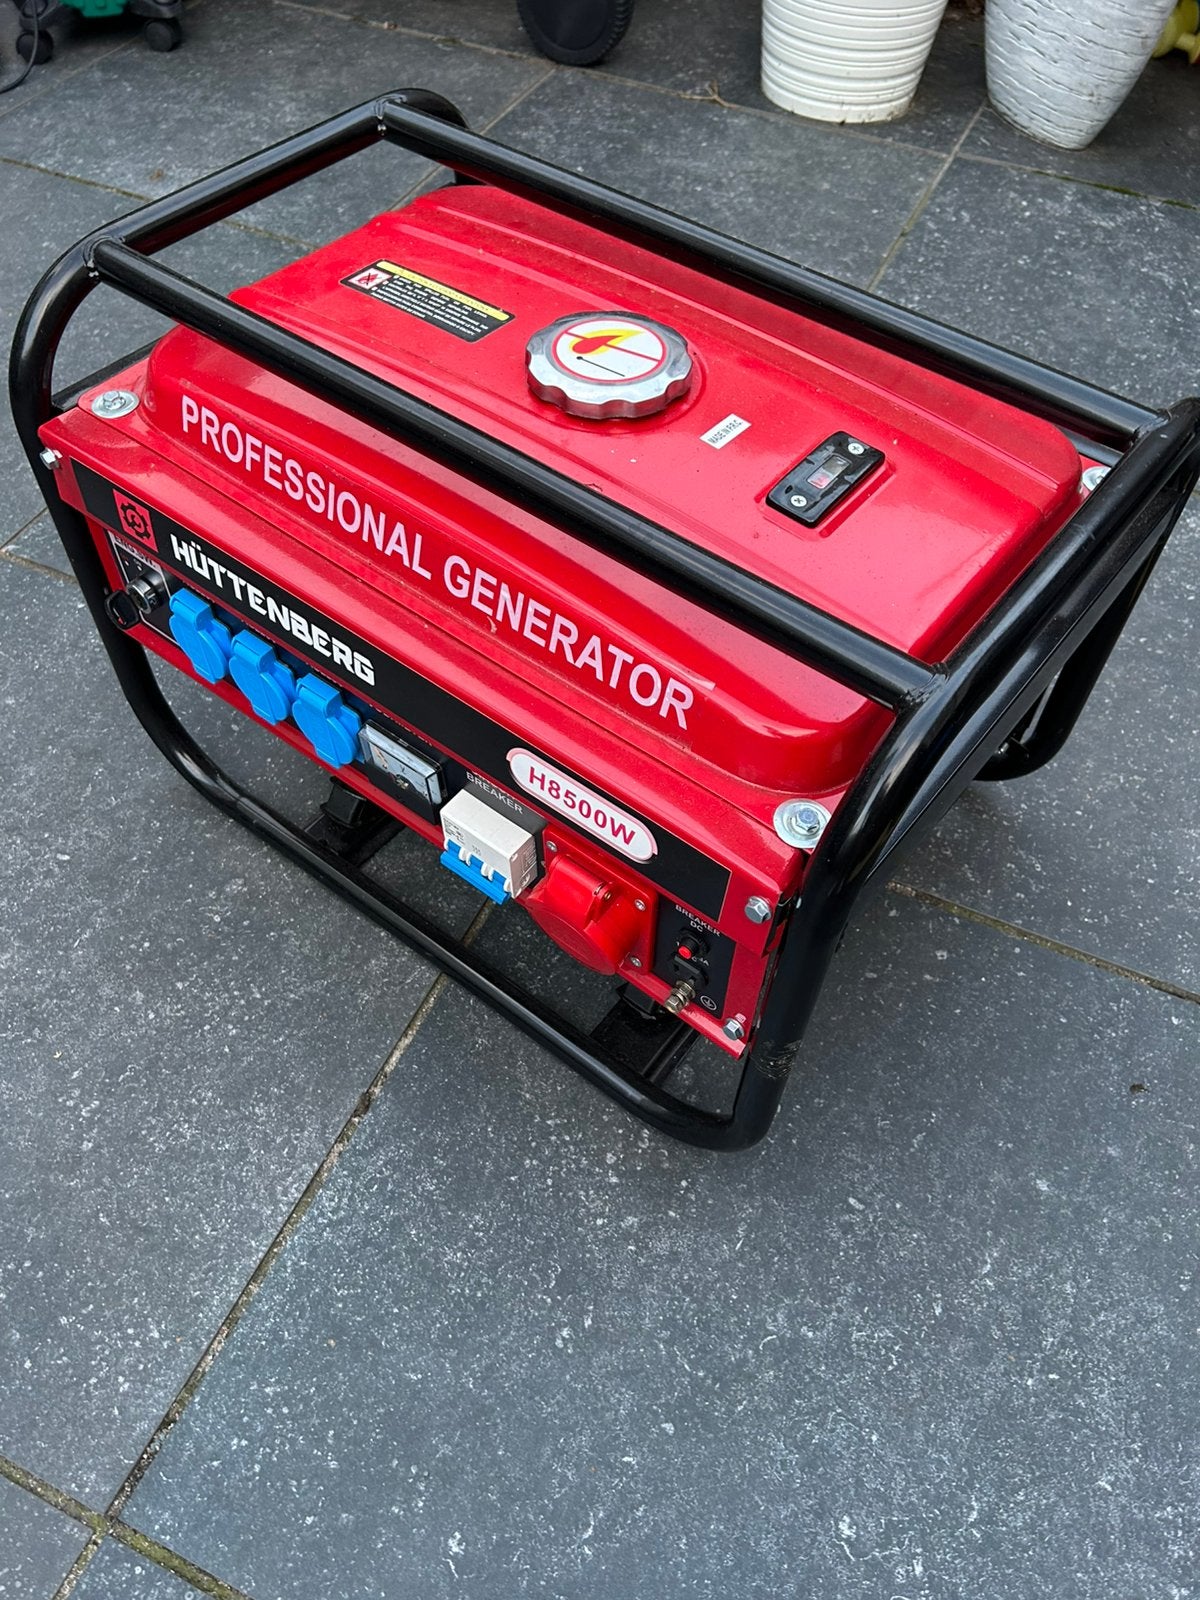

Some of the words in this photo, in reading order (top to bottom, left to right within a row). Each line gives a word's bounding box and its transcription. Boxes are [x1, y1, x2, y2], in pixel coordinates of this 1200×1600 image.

[181, 394, 433, 580] PROFESSIONAL
[443, 554, 694, 731] GENERATOR
[169, 533, 376, 686] HÜTTENBERG
[465, 770, 524, 815] BREAKER
[528, 766, 637, 846] H8500W
[675, 904, 721, 936] BREAKER
[690, 920, 704, 933] DC
